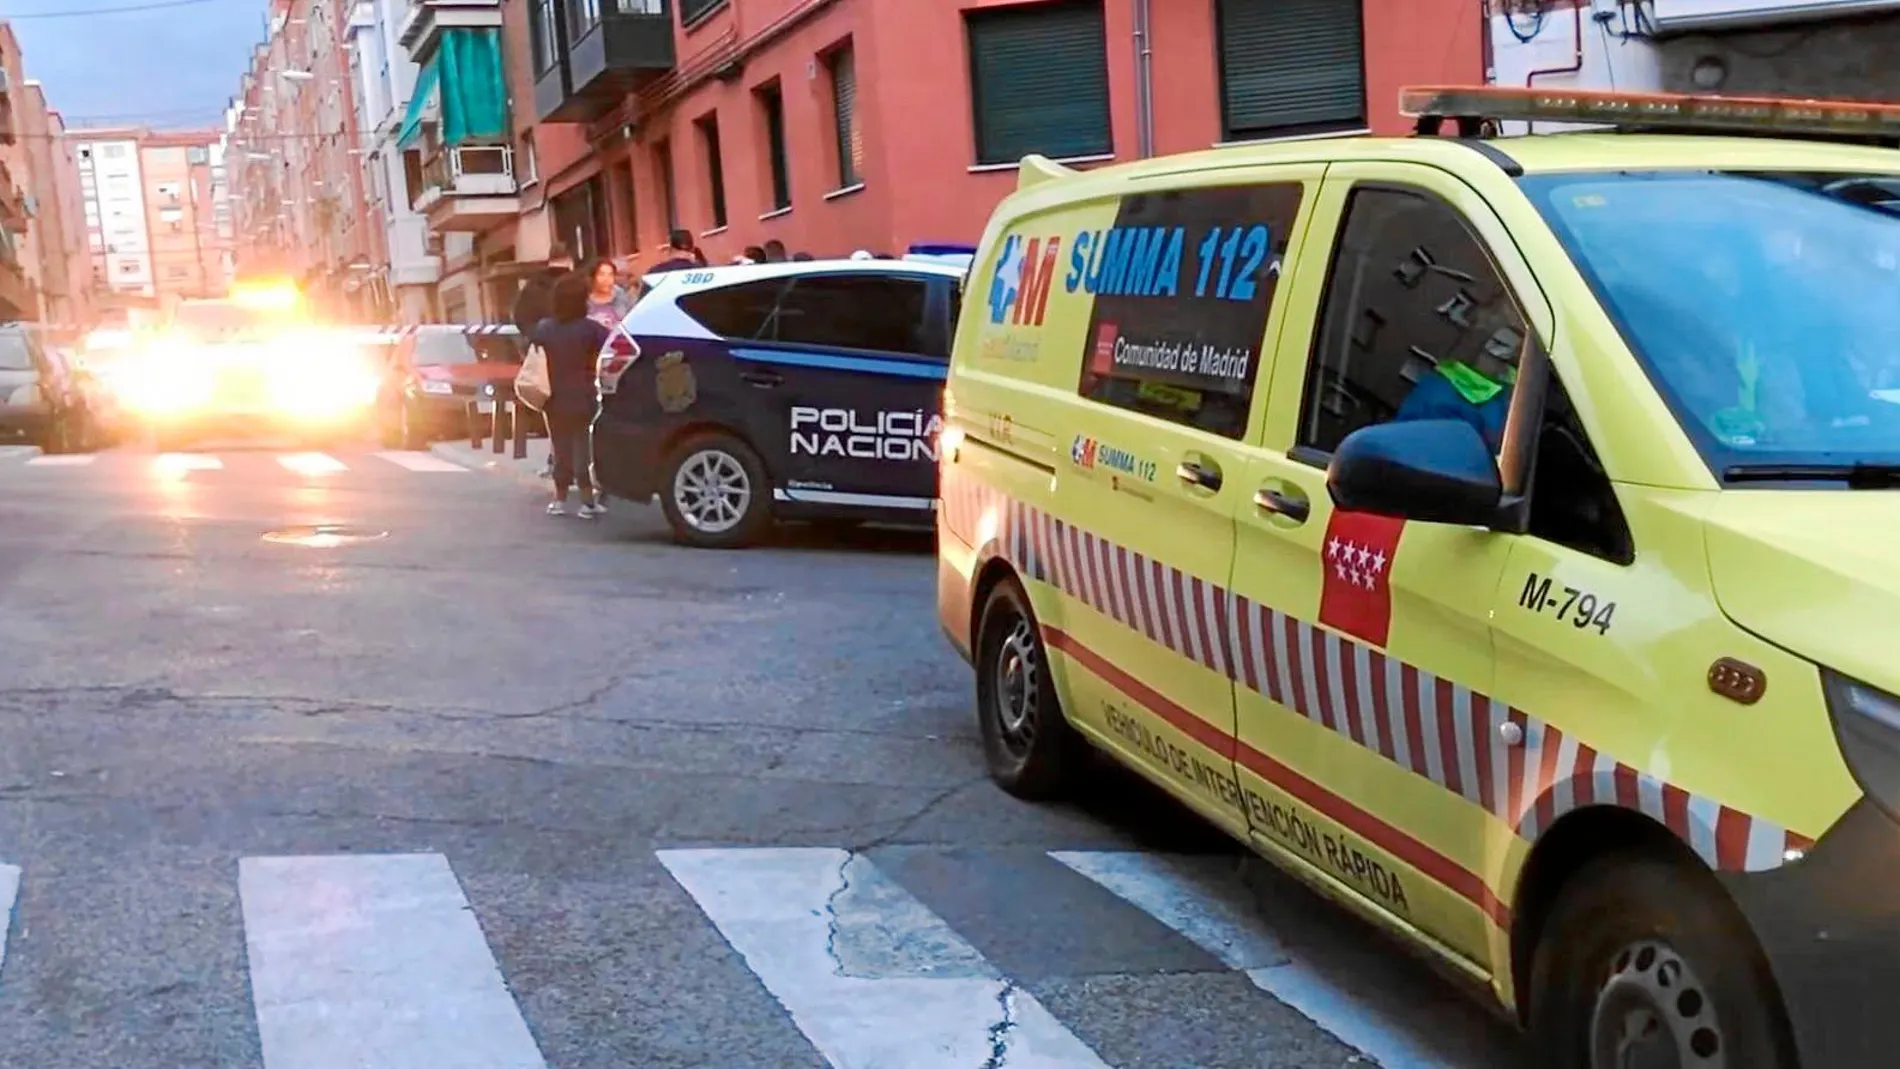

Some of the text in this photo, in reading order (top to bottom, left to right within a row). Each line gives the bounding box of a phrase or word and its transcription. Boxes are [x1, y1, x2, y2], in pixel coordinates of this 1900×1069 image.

[1065, 222, 1271, 301] SUMMA 112
[1114, 336, 1250, 380] Comunidad de Madrid
[790, 406, 944, 437] POLICÍA
[1098, 443, 1156, 482] SUMMA 112
[1519, 572, 1617, 635] M-794
[1167, 743, 1194, 781] DE
[1191, 756, 1323, 858] INTERVENCIÓN
[1323, 833, 1408, 911] RÁPIDA
